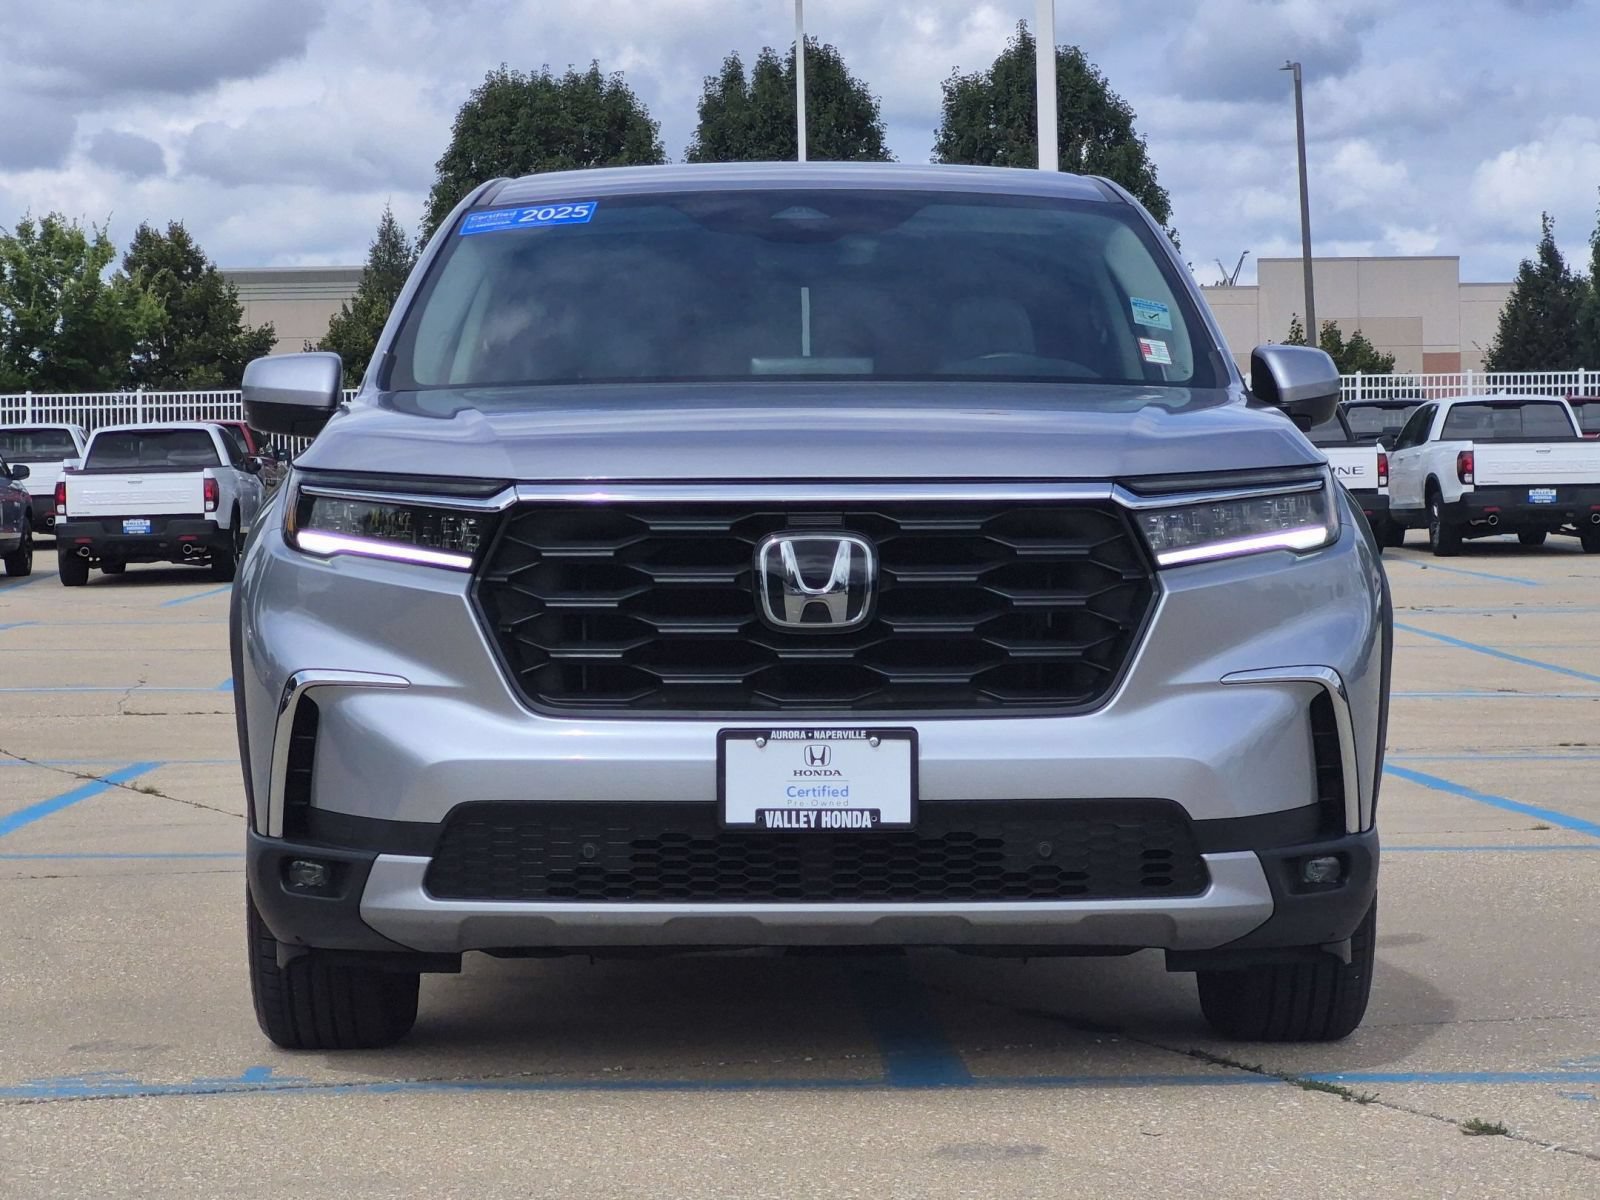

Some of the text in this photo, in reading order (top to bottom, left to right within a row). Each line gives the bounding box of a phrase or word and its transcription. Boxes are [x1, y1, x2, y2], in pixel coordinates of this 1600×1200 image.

[470, 211, 518, 221] Certified
[518, 205, 590, 223] 2025
[770, 730, 867, 739] AURORA NAPERVILLE
[786, 785, 849, 798] Certified
[787, 799, 849, 807] Pre-Owned
[764, 810, 872, 829] VALLEY HONDA
